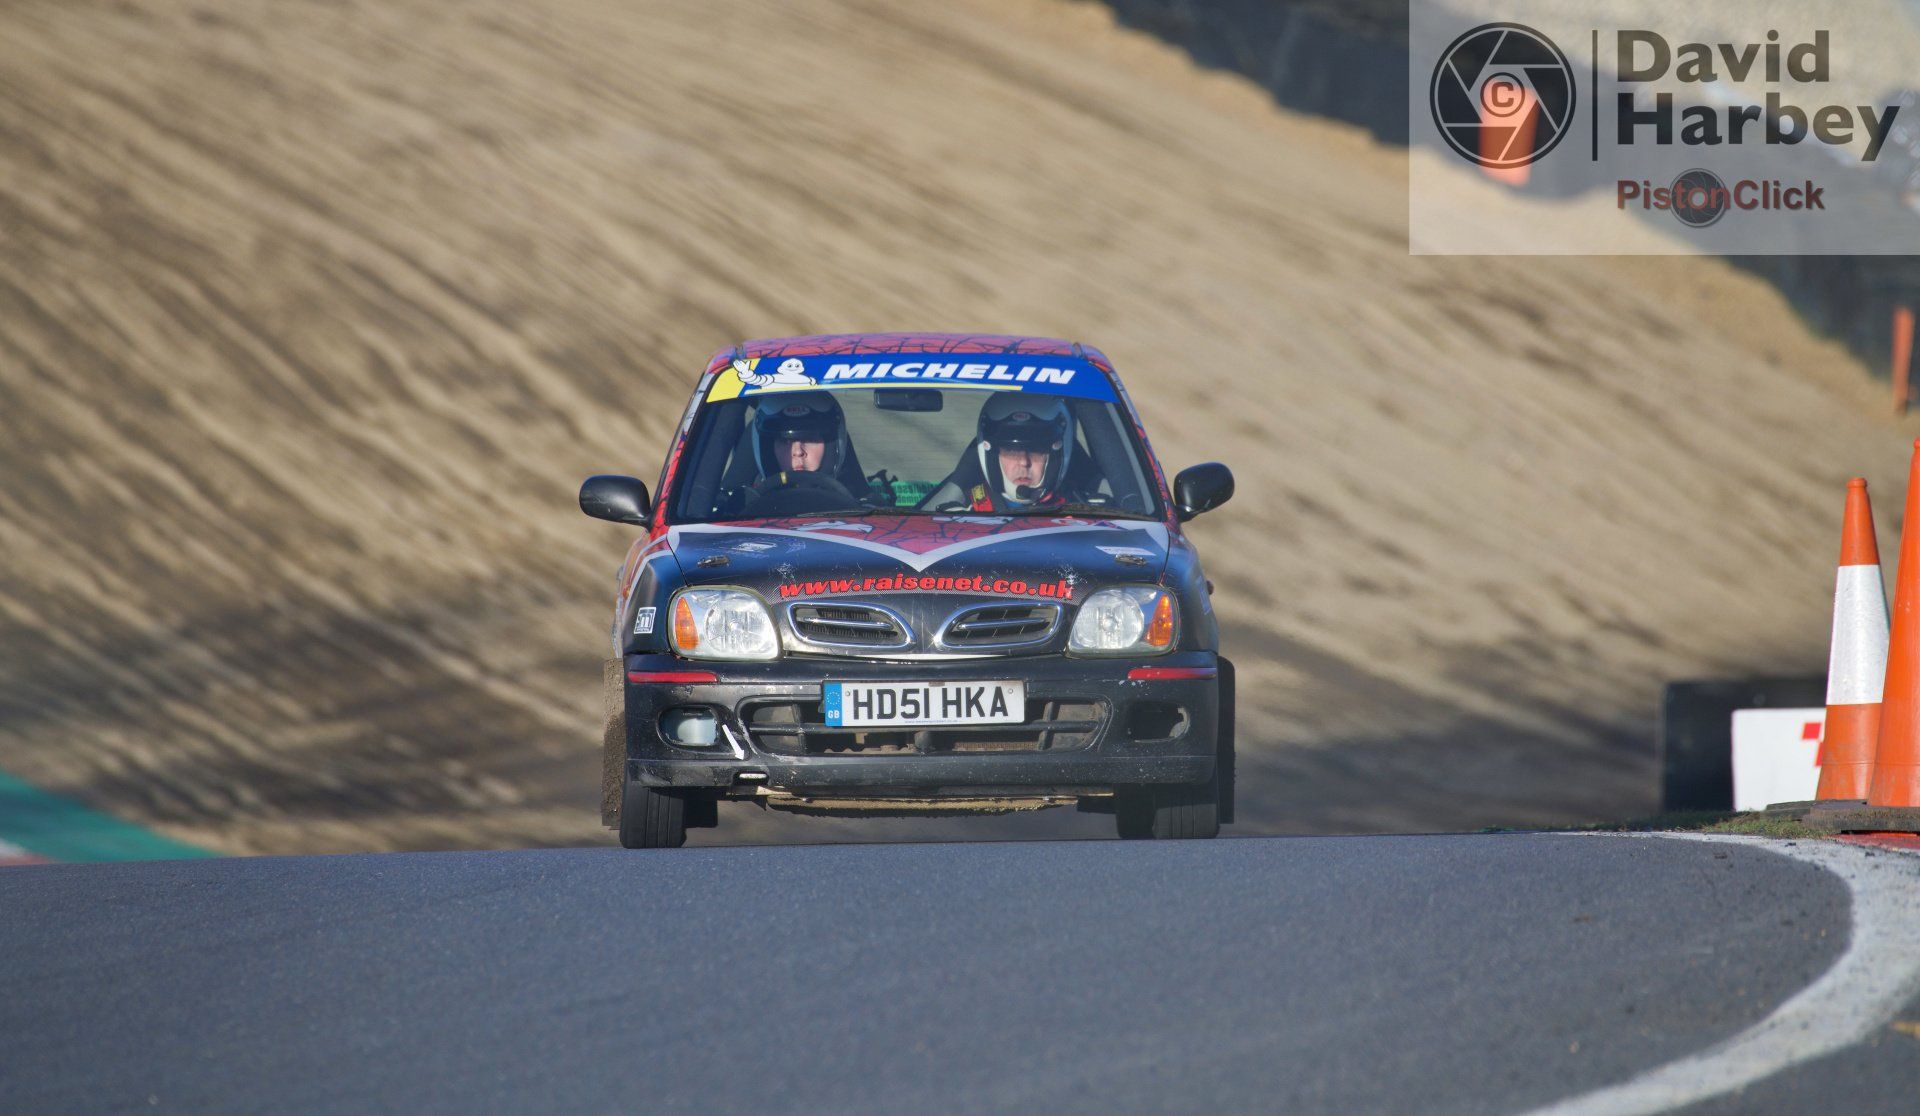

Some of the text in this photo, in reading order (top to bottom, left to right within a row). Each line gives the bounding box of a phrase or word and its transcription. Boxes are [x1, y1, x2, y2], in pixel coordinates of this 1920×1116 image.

[823, 362, 1076, 385] MICHELIN
[780, 573, 1073, 600] www.raisenet.co.uk
[828, 710, 840, 719] GB
[853, 687, 1009, 720] HD51 HKA
